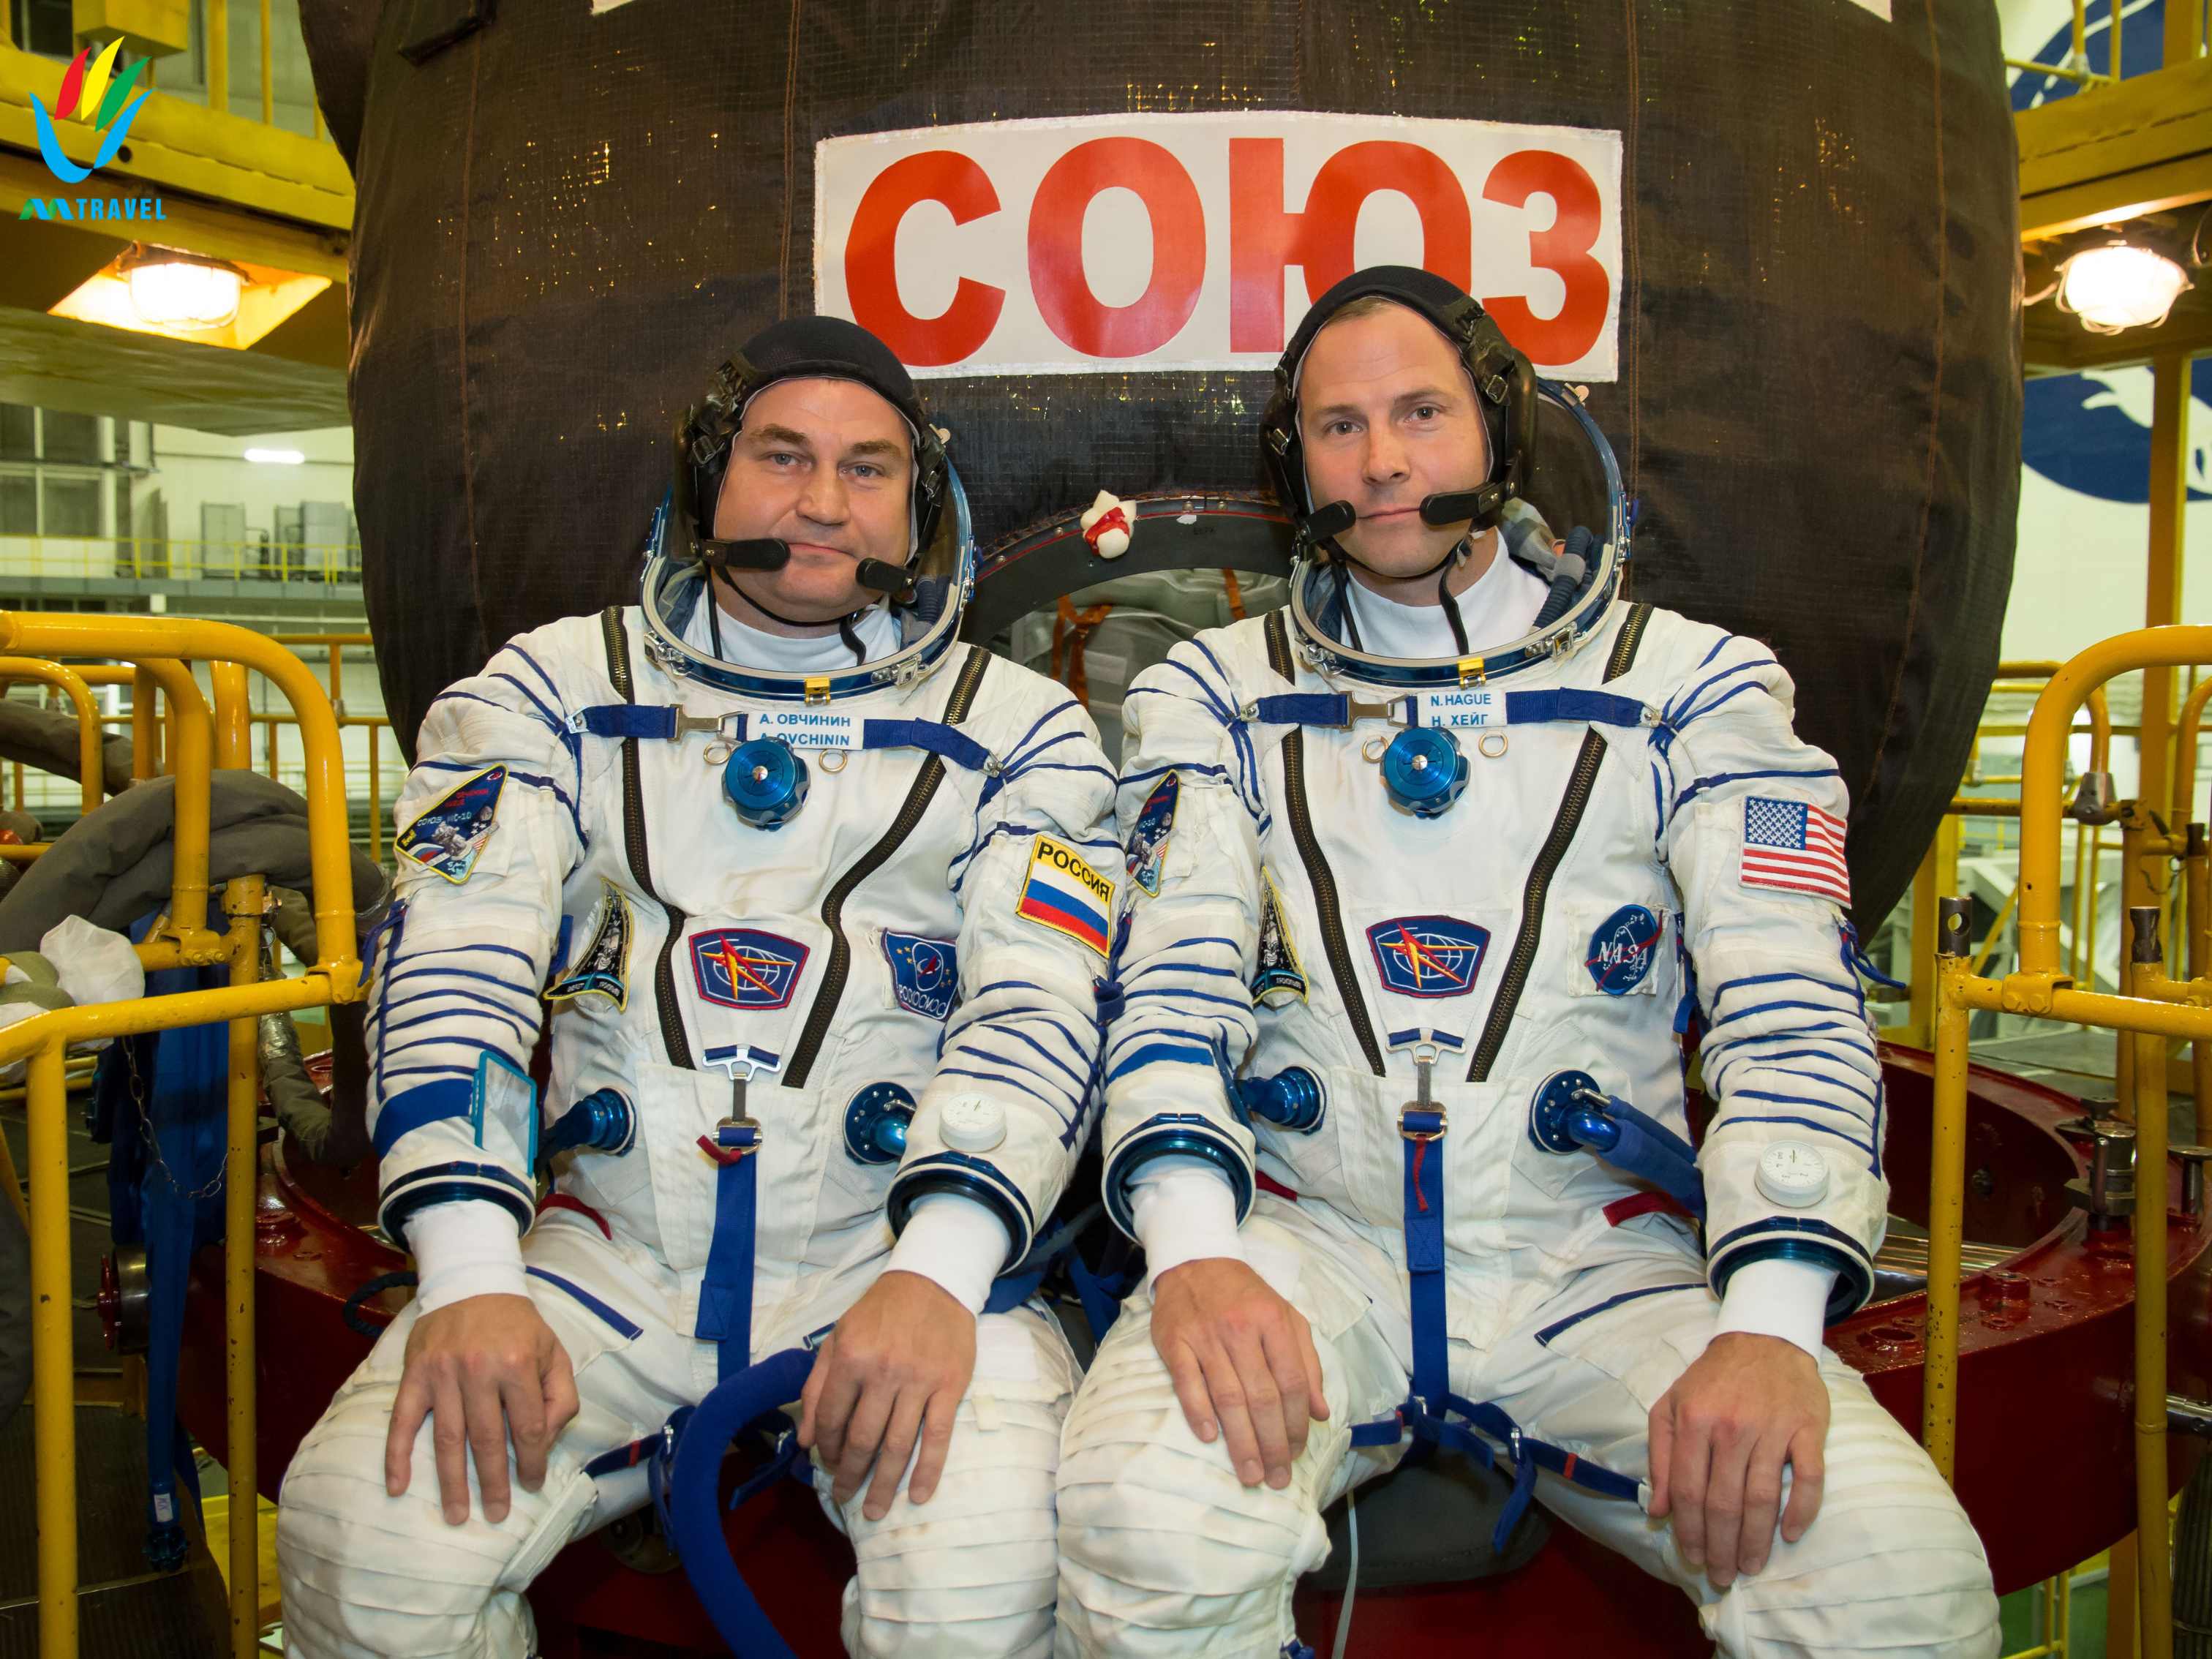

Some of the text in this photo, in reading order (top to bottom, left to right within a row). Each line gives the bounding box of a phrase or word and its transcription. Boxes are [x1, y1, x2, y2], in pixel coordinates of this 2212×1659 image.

[844, 136, 1609, 367] СОЮЗ
[1431, 693, 1491, 707] N. HAGUE
[759, 714, 851, 727] А. ОВЧИНИН
[1432, 712, 1489, 727] Н. ХЕЙГ
[1037, 841, 1110, 902] РОССИЯ
[1597, 941, 1648, 965] NASA
